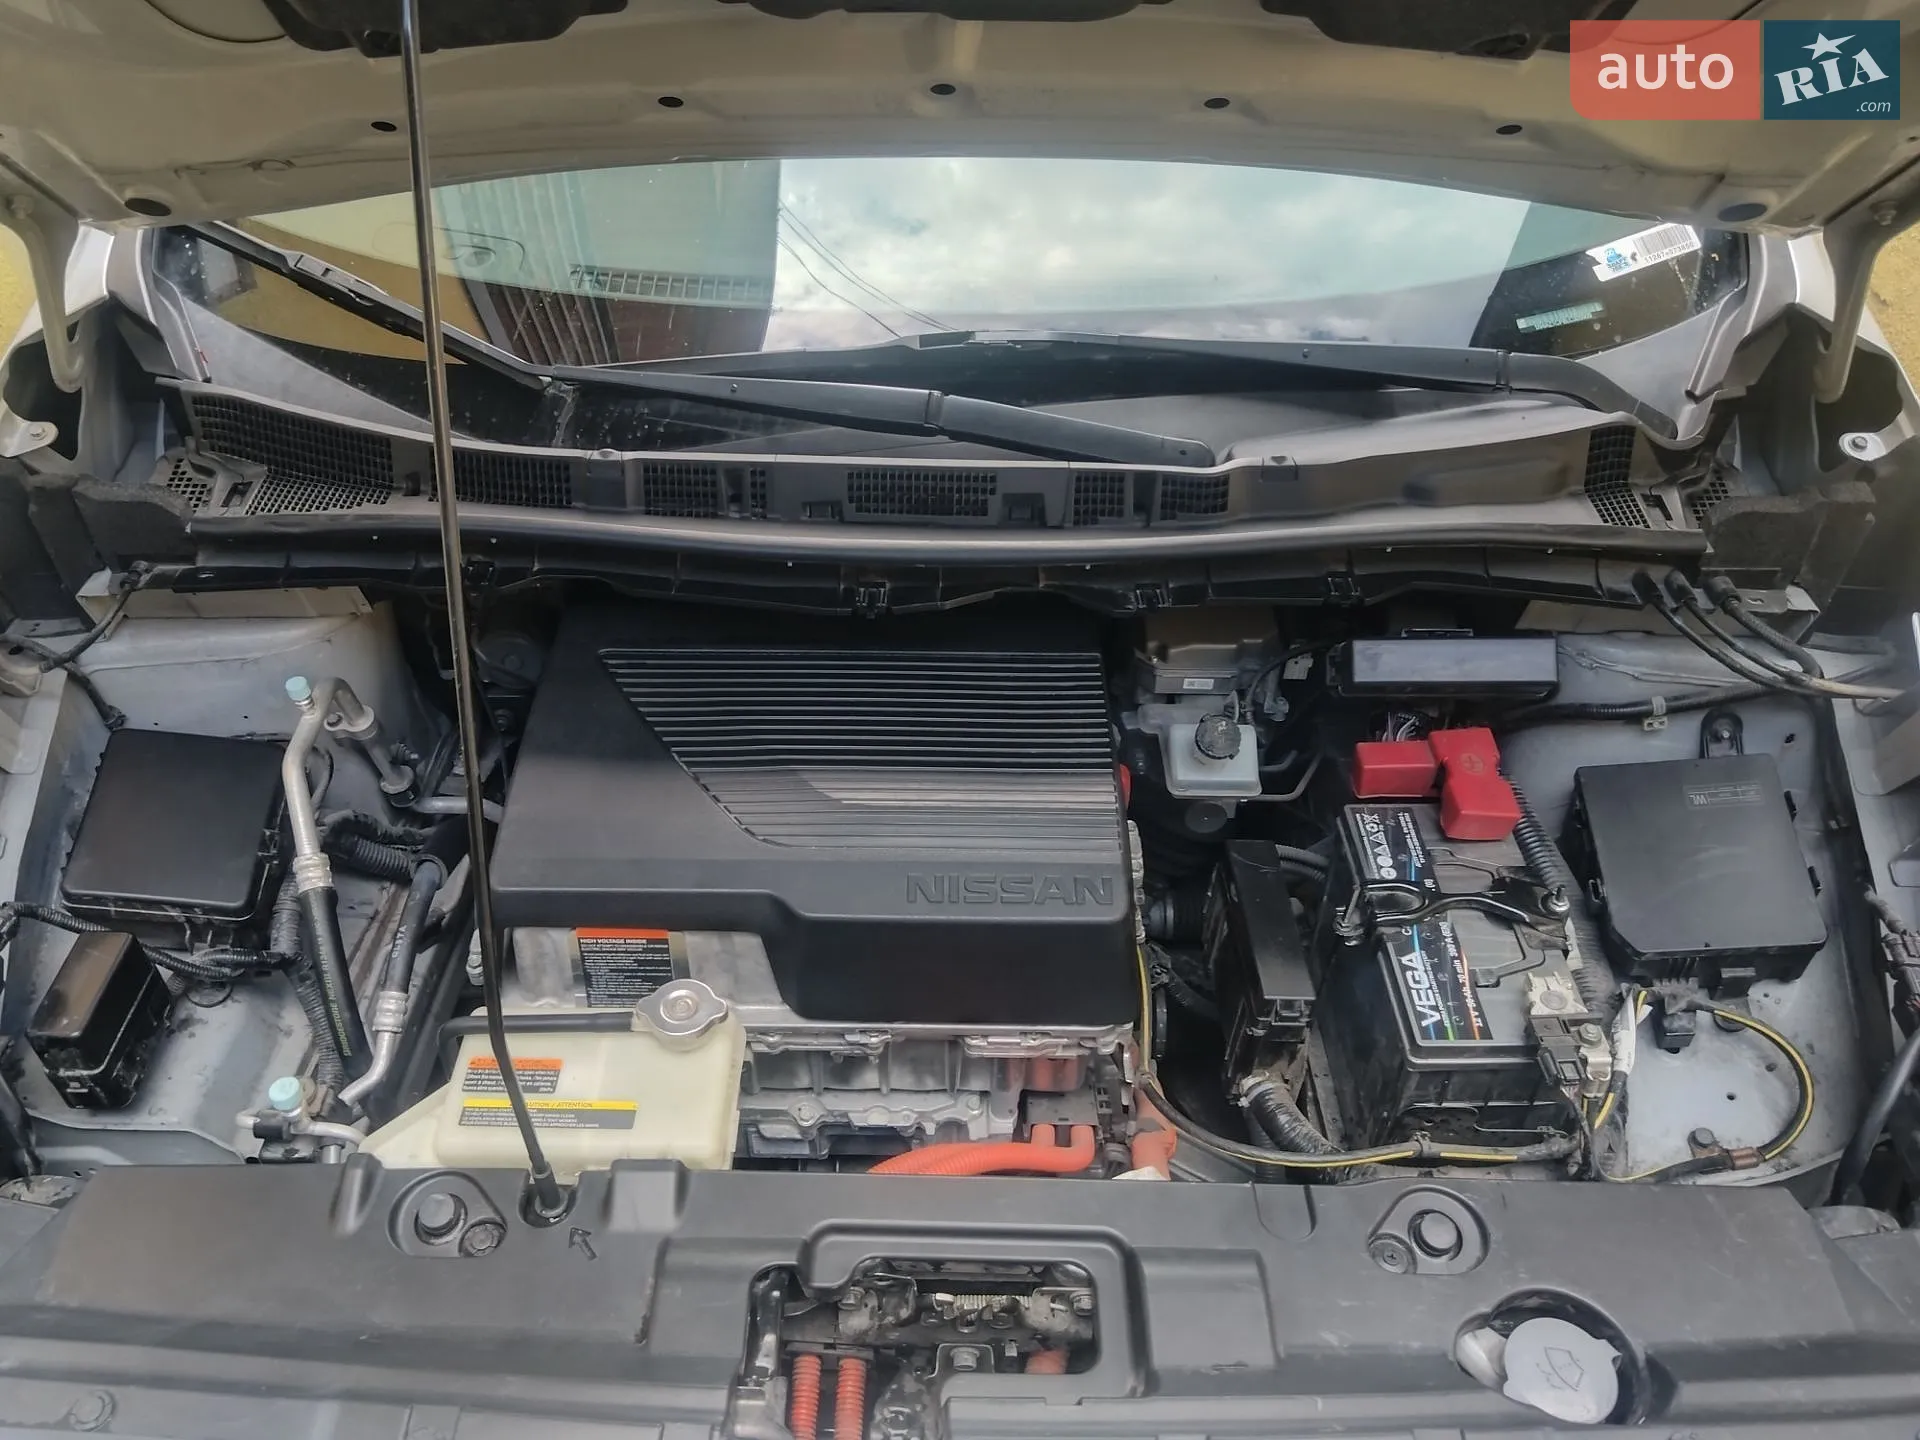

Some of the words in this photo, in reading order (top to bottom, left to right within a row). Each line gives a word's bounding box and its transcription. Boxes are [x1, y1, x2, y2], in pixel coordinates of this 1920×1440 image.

[907, 873, 1113, 905] NISSAN
[1399, 951, 1441, 1027] VEGA
[556, 1101, 593, 1109] ATTENTION
